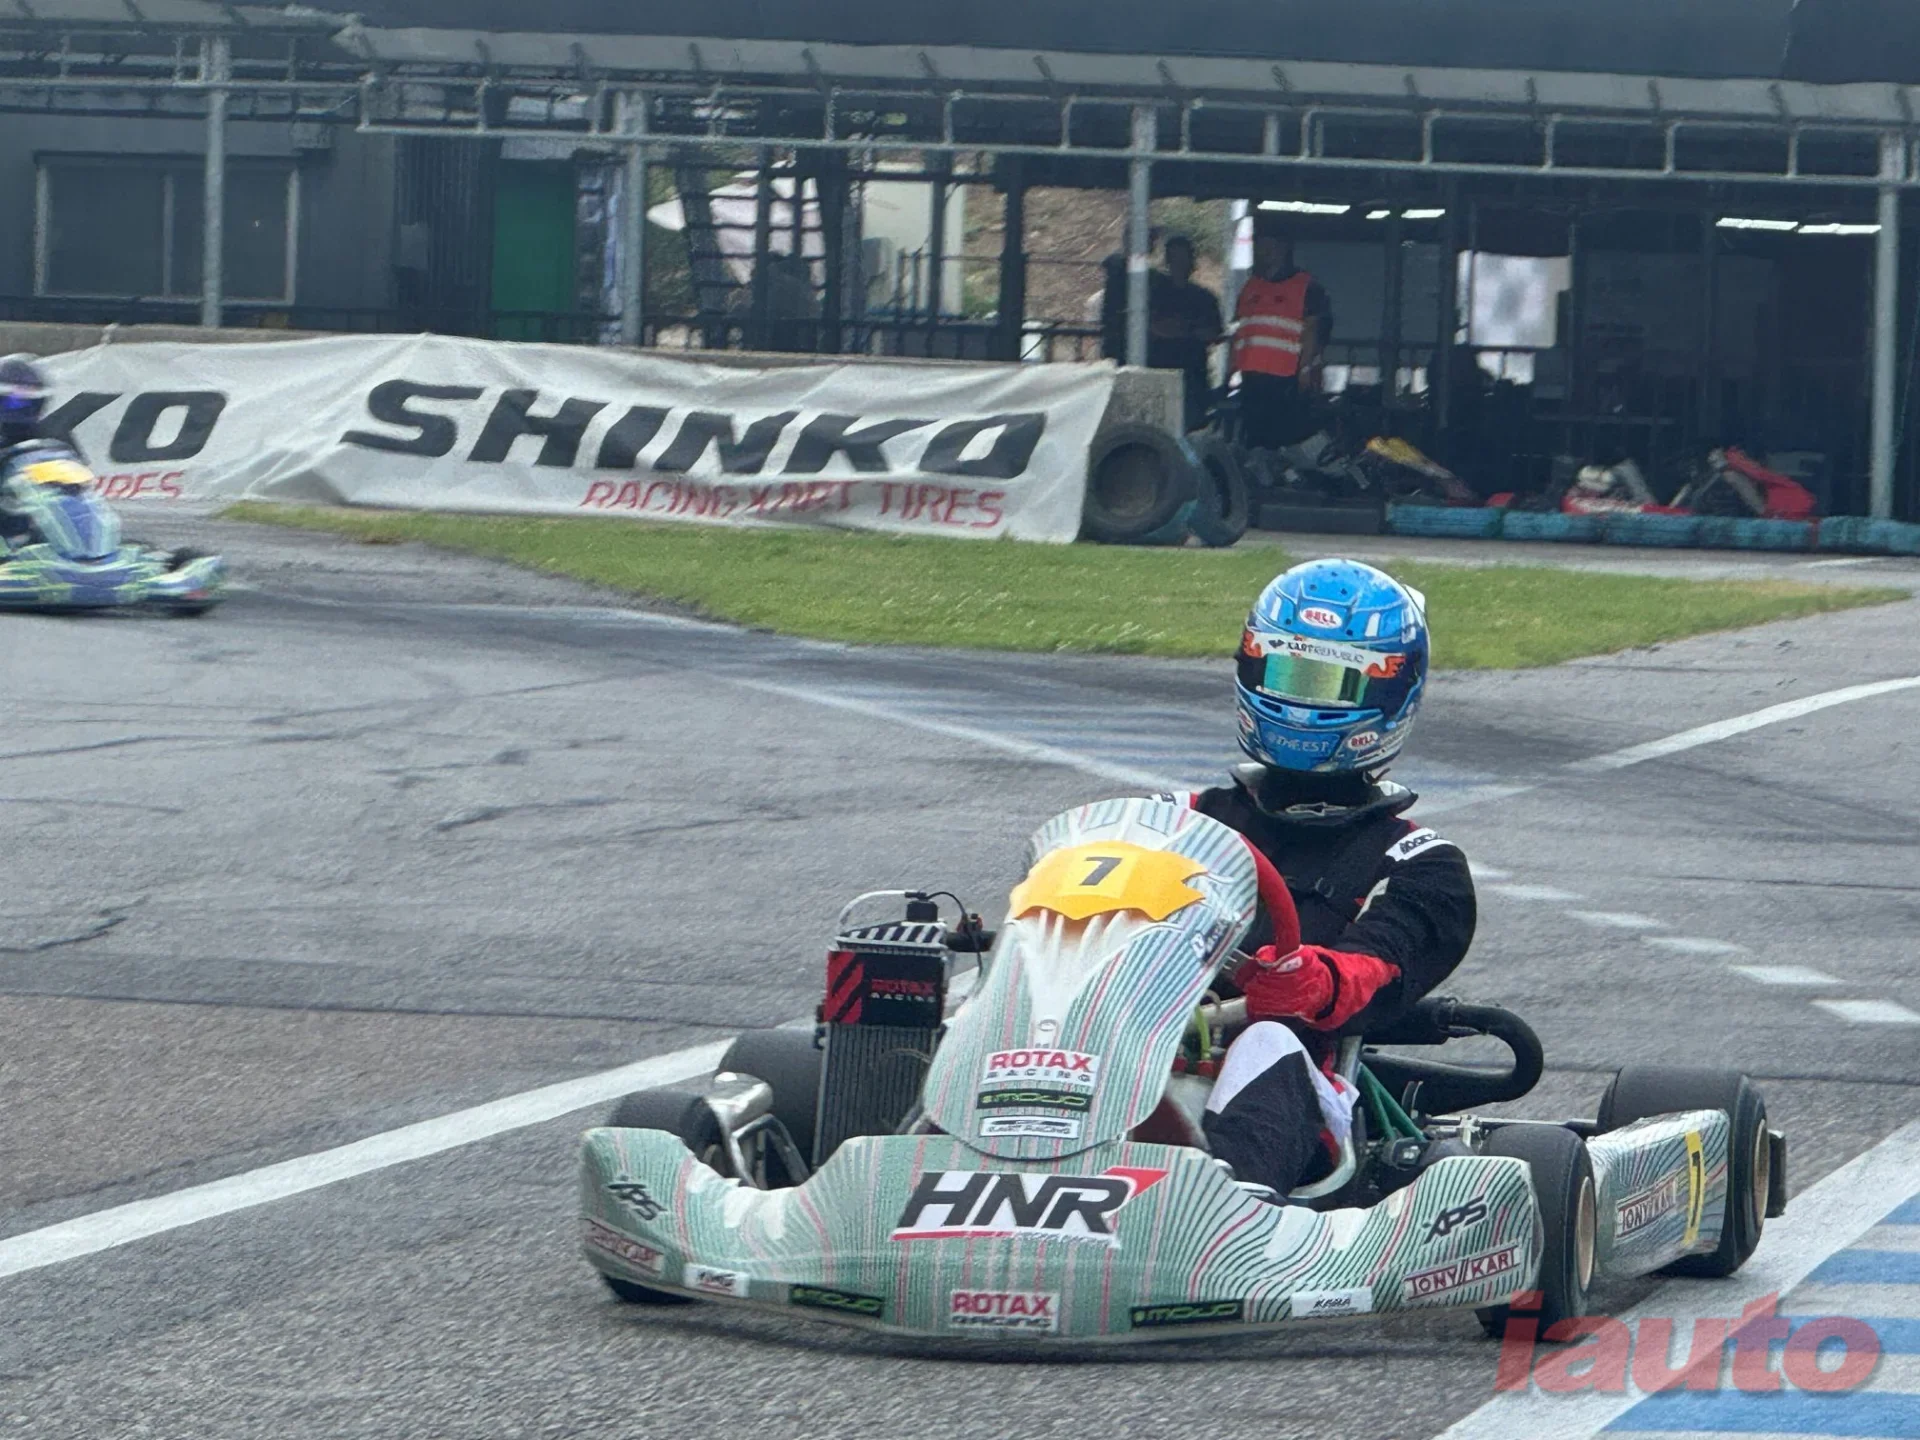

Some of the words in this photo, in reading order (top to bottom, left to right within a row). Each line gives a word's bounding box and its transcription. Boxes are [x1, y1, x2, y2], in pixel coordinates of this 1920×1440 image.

[341, 379, 1046, 479] SHINKO
[93, 470, 186, 498] IRES
[579, 480, 737, 518] RACING
[872, 481, 1007, 529] TIRES
[1079, 856, 1124, 887] 7
[988, 1050, 1095, 1074] ROTAX
[896, 1171, 1131, 1234] HNR
[952, 1292, 1052, 1315] ROTAX
